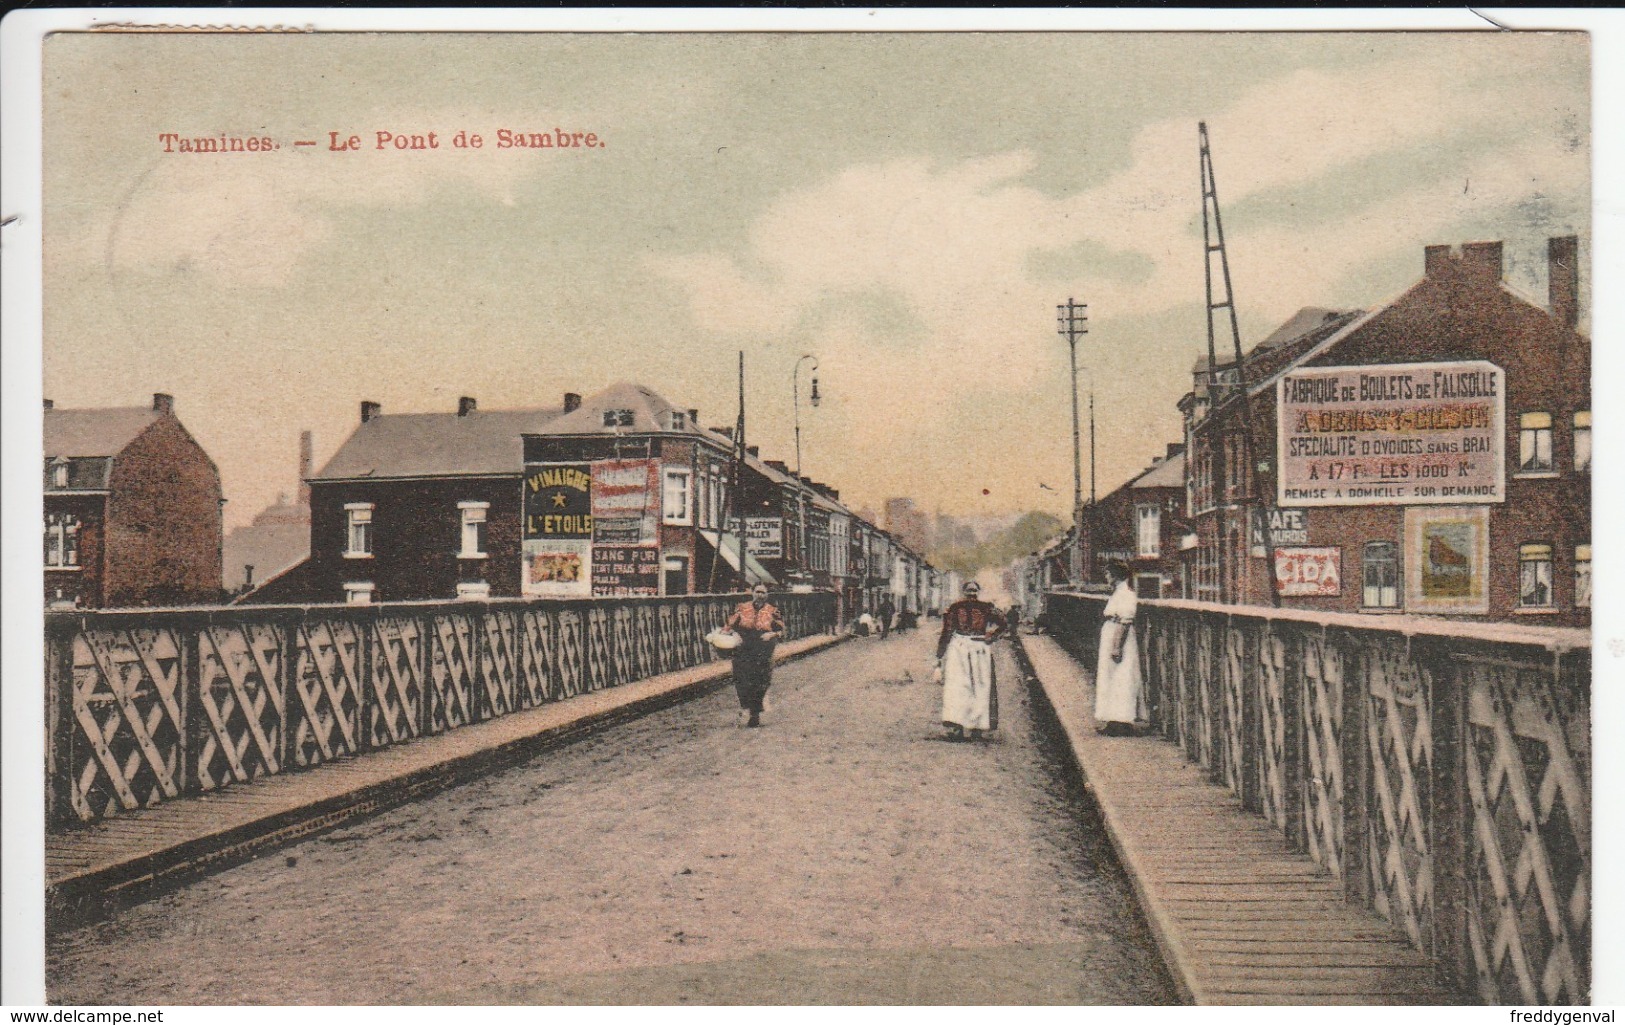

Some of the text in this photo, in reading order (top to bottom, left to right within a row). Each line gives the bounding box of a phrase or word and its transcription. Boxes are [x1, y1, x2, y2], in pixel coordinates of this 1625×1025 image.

[1284, 377, 1339, 403] FABRIQUE
[1360, 374, 1412, 401] BOULETS
[1434, 371, 1497, 398] FALISOLLE
[1427, 442, 1458, 453] SANS
[1463, 437, 1490, 453] BRAI
[1328, 463, 1344, 480] 17
[1381, 463, 1409, 479] LES
[1416, 464, 1449, 479] 1000
[529, 469, 591, 493] VINAIGRE
[1284, 488, 1327, 499] REMISE
[1350, 487, 1405, 498] DOMICILE
[1414, 486, 1436, 497] SUR
[1442, 485, 1496, 497] DEMANDE
[528, 515, 591, 534] L'ETOILE
[1253, 529, 1307, 543] NMUROIS
[594, 550, 656, 562] SANG PUR
